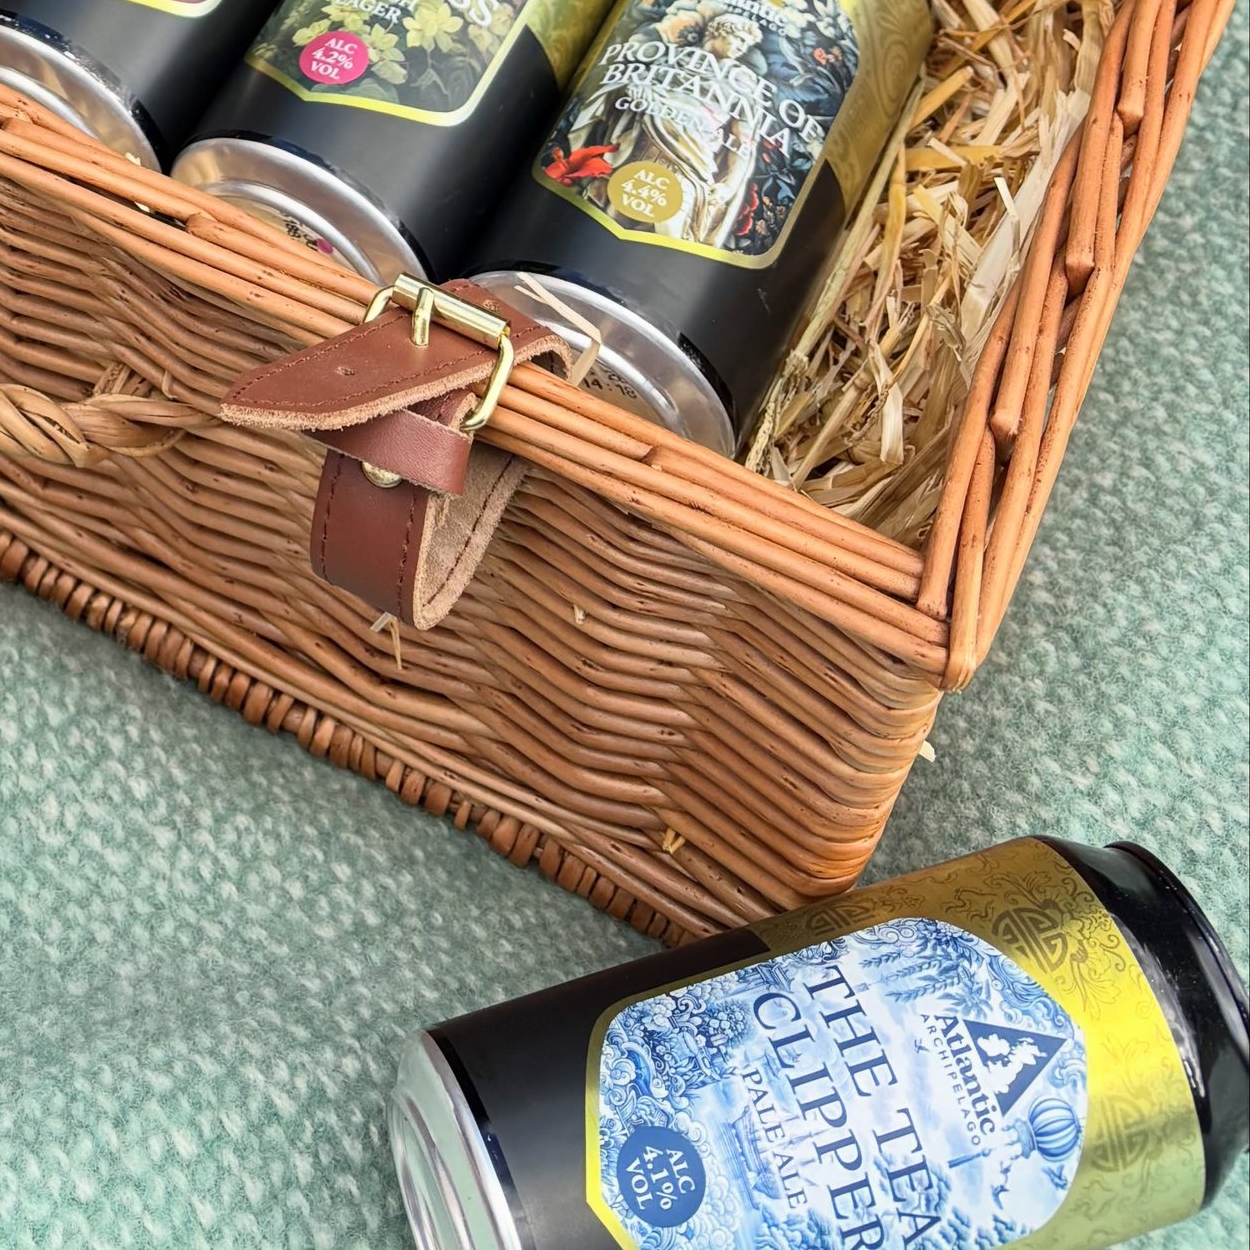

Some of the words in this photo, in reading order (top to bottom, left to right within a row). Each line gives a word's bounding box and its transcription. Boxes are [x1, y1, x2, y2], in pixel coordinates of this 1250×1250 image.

[310, 60, 341, 81] VOL
[311, 46, 354, 71] 4.2%
[324, 37, 358, 55] ALC
[599, 41, 777, 108] PROVINCE
[778, 98, 825, 146] OF
[600, 63, 792, 158] BRITANNIA
[620, 178, 668, 208] 4.4%
[622, 193, 656, 218] VOL
[633, 167, 671, 191] ALC
[920, 1013, 982, 1146] ARCHIPELAGO
[934, 1014, 997, 1136] Atlantic
[753, 991, 885, 1250] CLIPPER
[803, 964, 898, 1097] THE
[872, 1107, 942, 1250] TEA
[741, 1067, 786, 1143] PALE
[772, 1151, 808, 1209] ALE
[625, 1157, 653, 1211] VOL
[642, 1146, 678, 1210] 4.1%
[666, 1148, 696, 1194] ALC
